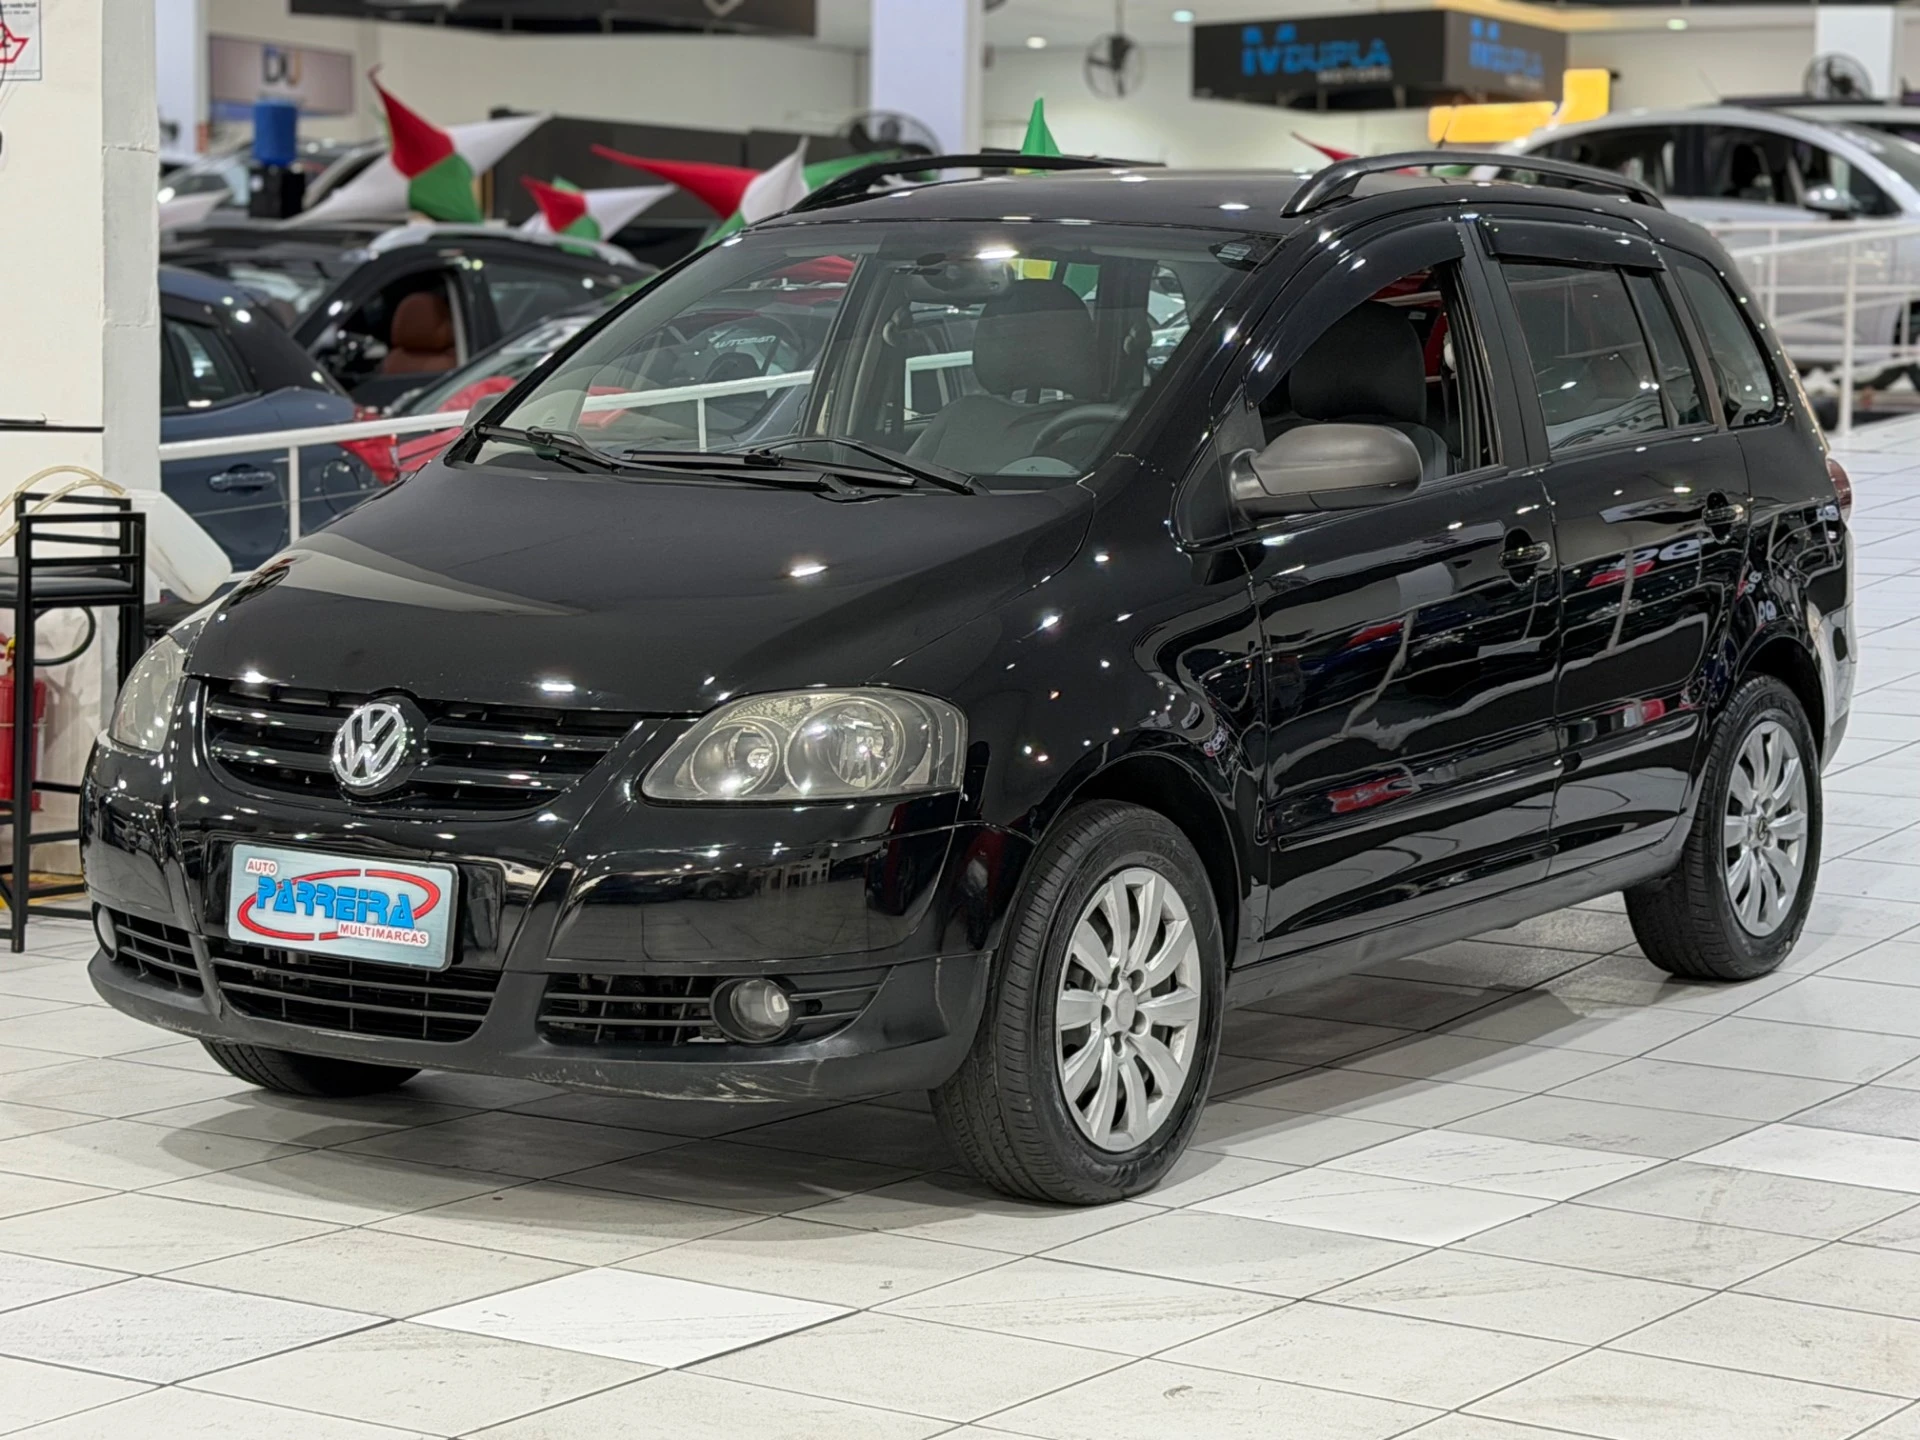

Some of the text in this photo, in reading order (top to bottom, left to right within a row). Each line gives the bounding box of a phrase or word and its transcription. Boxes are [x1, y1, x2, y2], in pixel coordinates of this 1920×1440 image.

[247, 860, 277, 875] AUTO
[256, 875, 415, 929] PARREIRA
[339, 923, 427, 945] MULTIMARCAS
